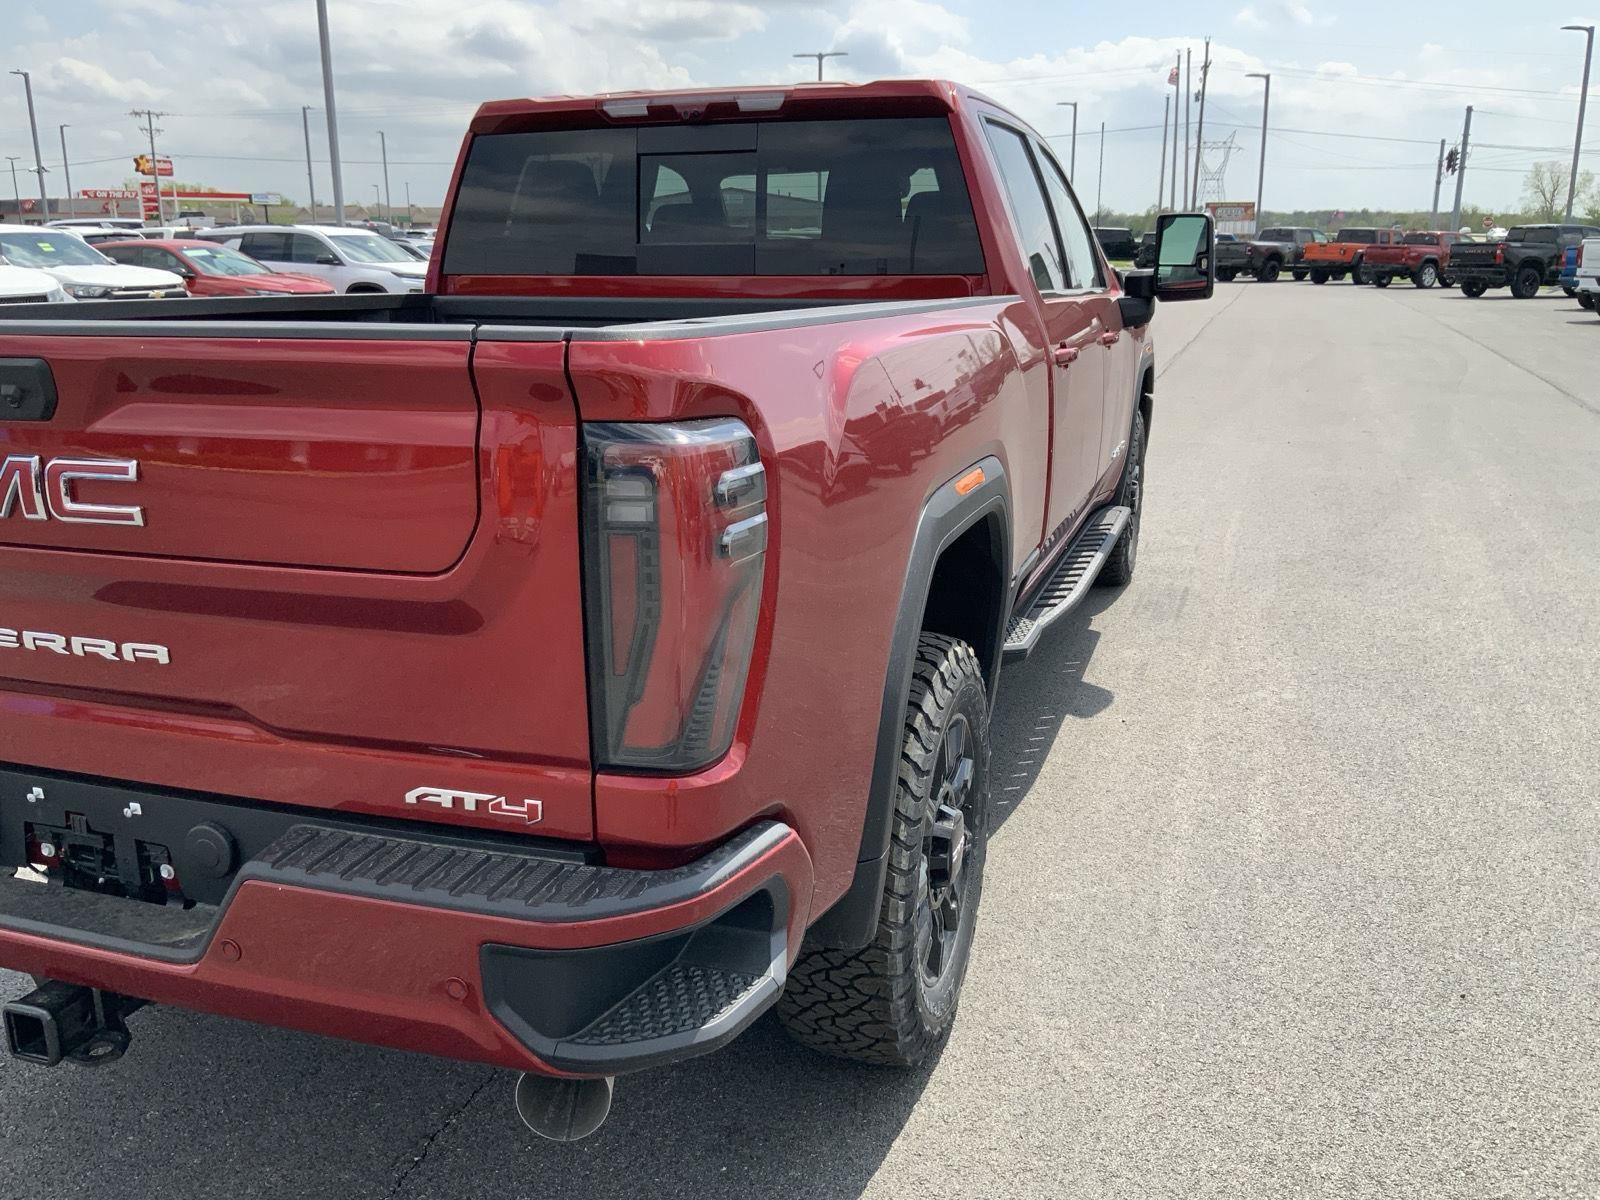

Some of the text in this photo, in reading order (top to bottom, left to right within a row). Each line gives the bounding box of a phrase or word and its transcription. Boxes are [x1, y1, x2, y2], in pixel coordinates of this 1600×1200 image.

[96, 190, 137, 199] ON THE FLY
[404, 786, 543, 825] AT4
